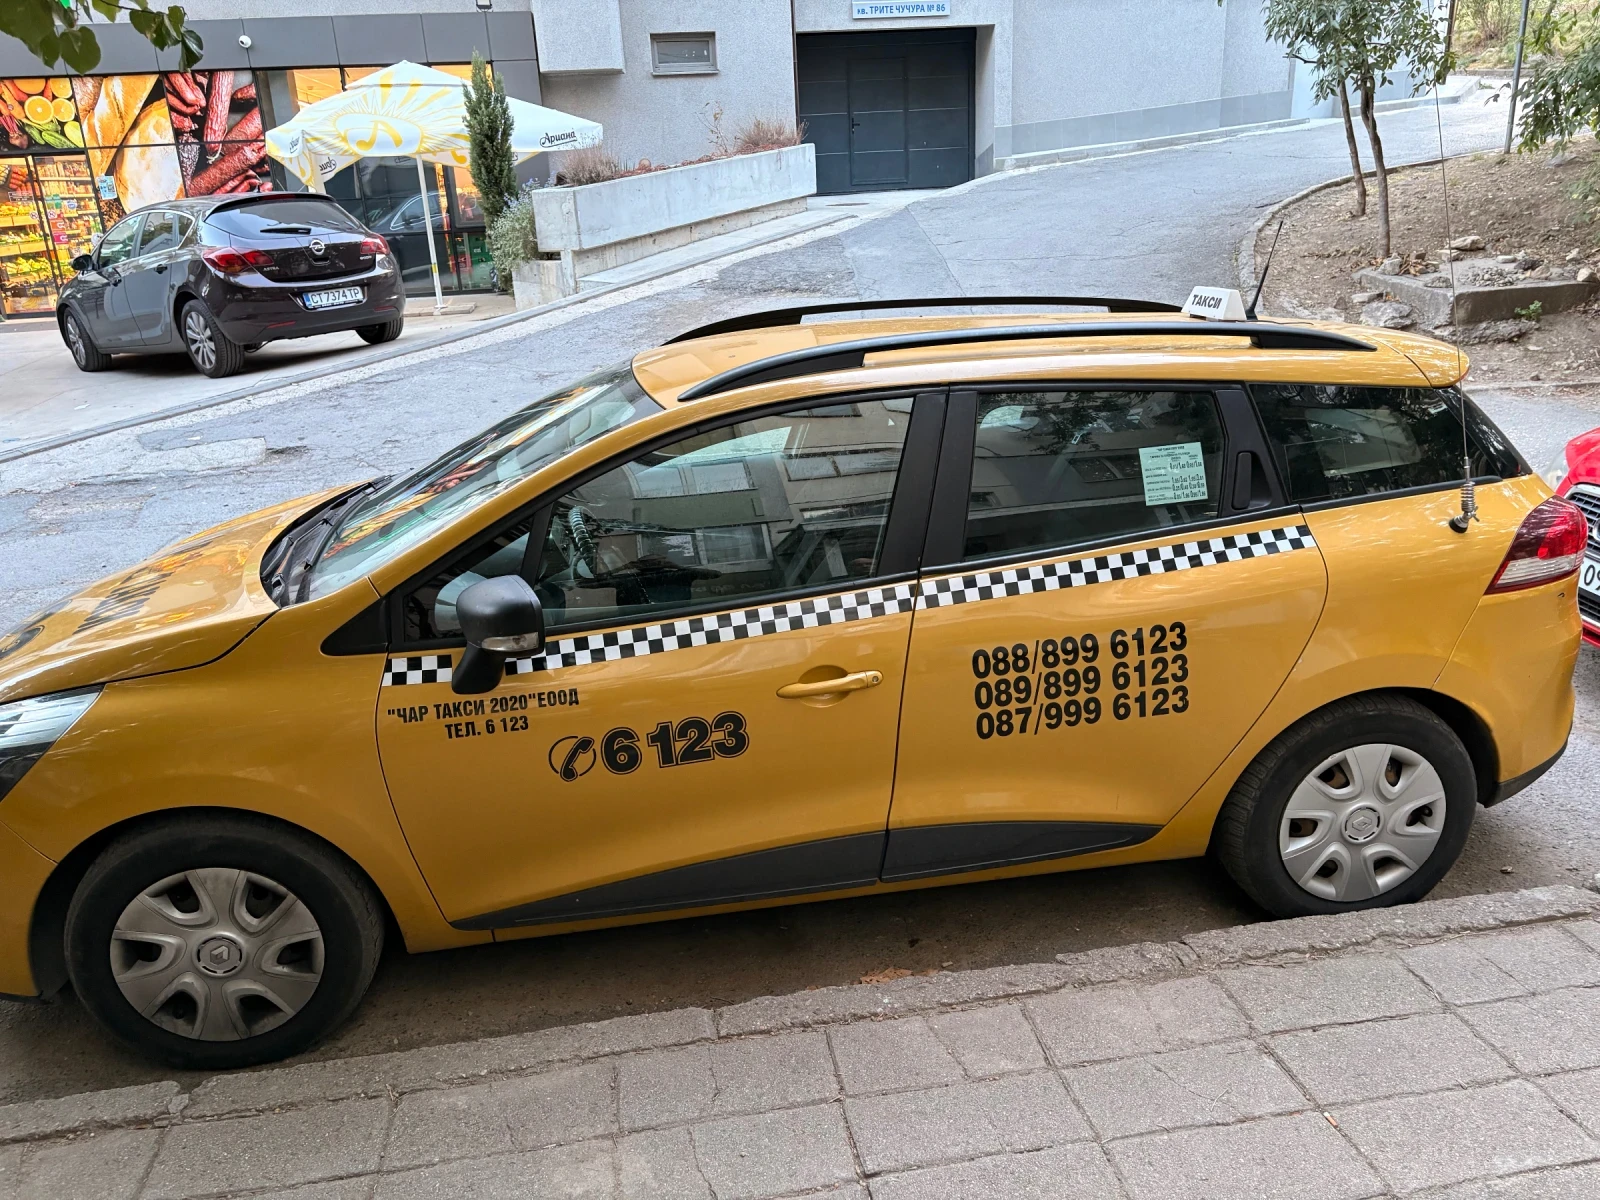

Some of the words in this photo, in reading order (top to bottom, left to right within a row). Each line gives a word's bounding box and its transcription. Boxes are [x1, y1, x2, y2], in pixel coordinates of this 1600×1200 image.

[869, 5, 894, 14] ТРИТЕ
[896, 4, 925, 14] ЧУЧУРА
[936, 3, 946, 12] 86
[539, 130, 578, 148] Ариана
[323, 289, 348, 303] 7374
[1191, 294, 1223, 309] ТАКСИ
[971, 632, 1100, 679] 088/899
[1110, 621, 1188, 660] 6123
[974, 665, 1101, 710] 089/899
[1112, 653, 1189, 691] 6123
[387, 705, 429, 724] "ЧАР
[433, 699, 485, 720] ТАКСИ
[976, 696, 1102, 740] 087/999
[1112, 685, 1190, 721] 6123
[444, 721, 481, 739] ТЕЛ.
[485, 718, 496, 734] 6
[499, 715, 529, 733] 123
[600, 726, 643, 775] 6
[646, 710, 750, 768] 123
